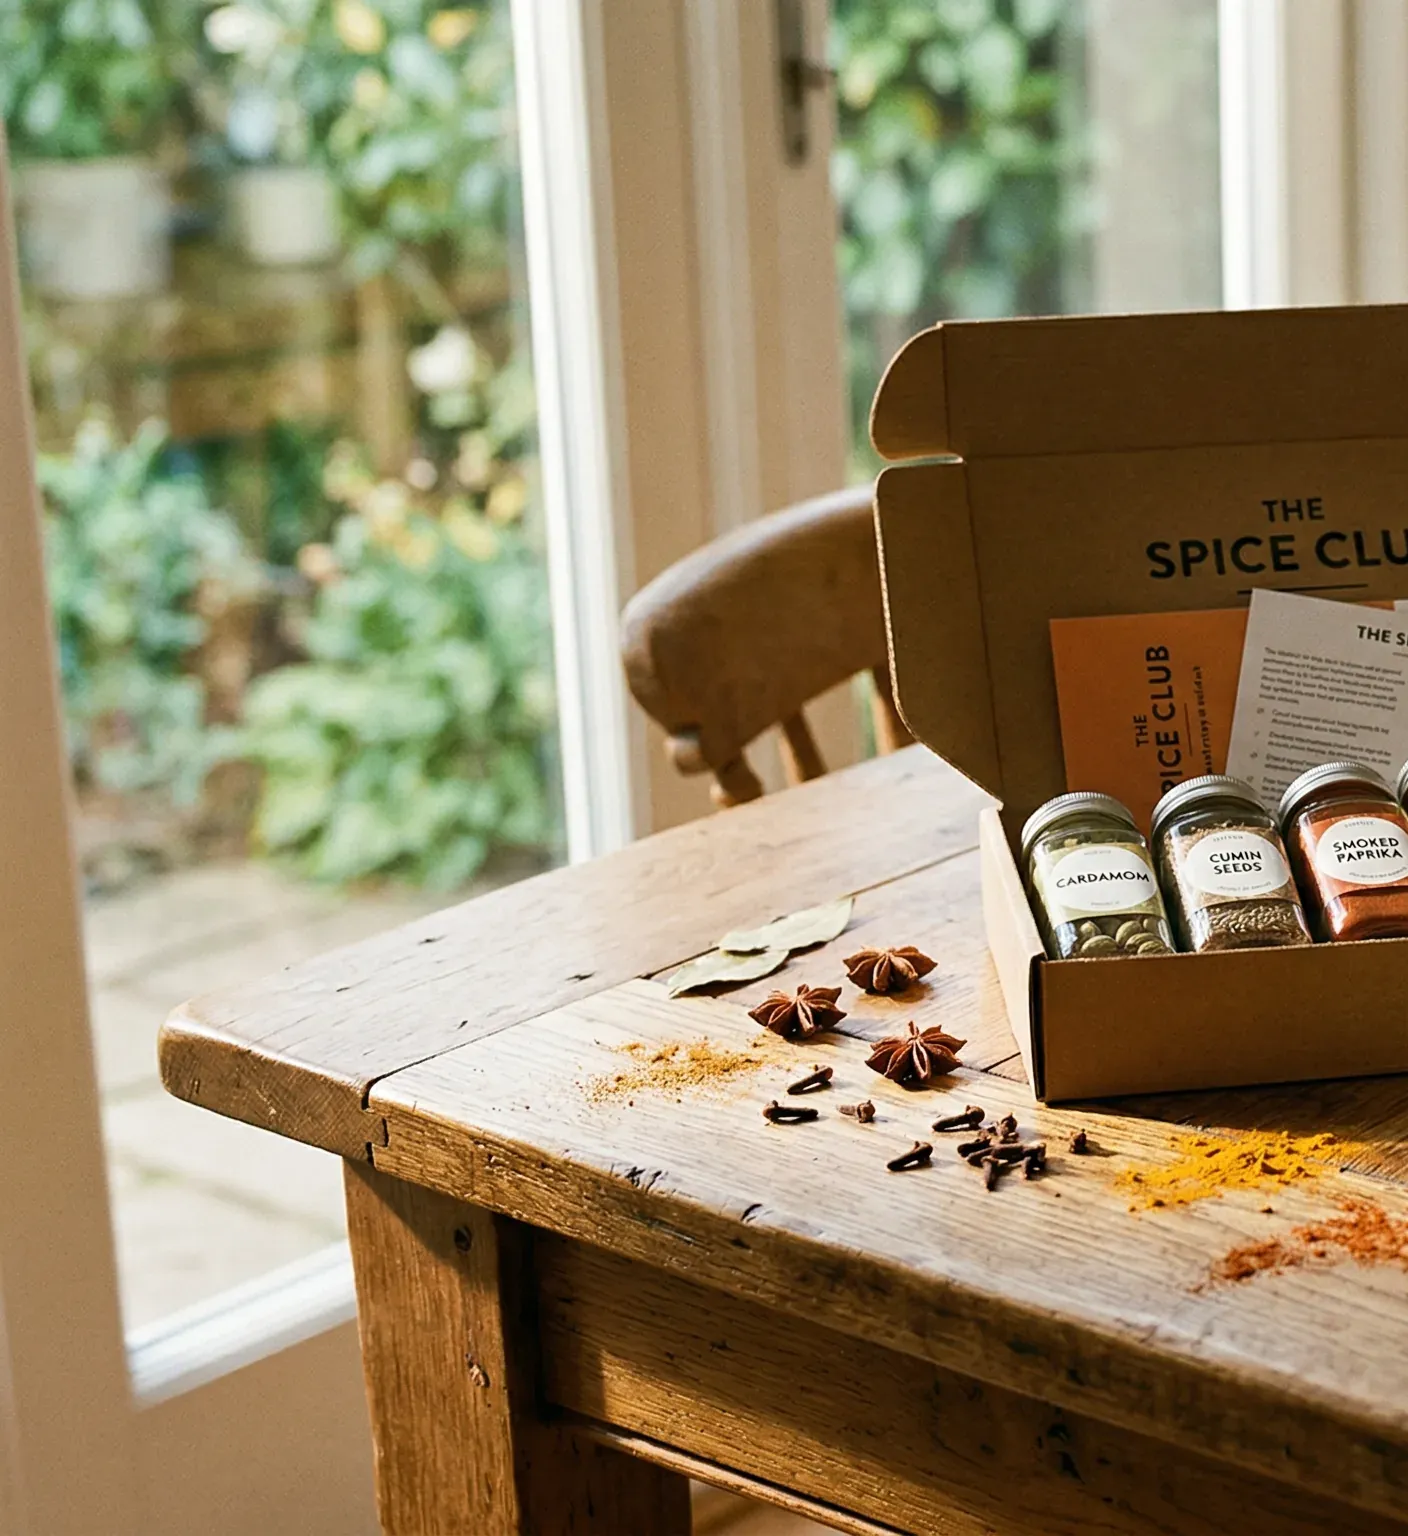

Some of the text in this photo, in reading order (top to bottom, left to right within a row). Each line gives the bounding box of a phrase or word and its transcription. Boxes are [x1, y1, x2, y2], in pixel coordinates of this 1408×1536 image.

[1262, 498, 1325, 522] THE
[1146, 534, 1299, 579] SPICE
[1357, 625, 1392, 643] THE
[1146, 645, 1183, 795] PICE CLUB
[1133, 714, 1149, 748] THE
[1333, 837, 1399, 852] SMOKED
[1209, 851, 1262, 863] CUMIN
[1337, 848, 1403, 863] PAPRIKA
[1213, 862, 1262, 875] SEEDS
[1056, 871, 1150, 888] CARDAMOM
